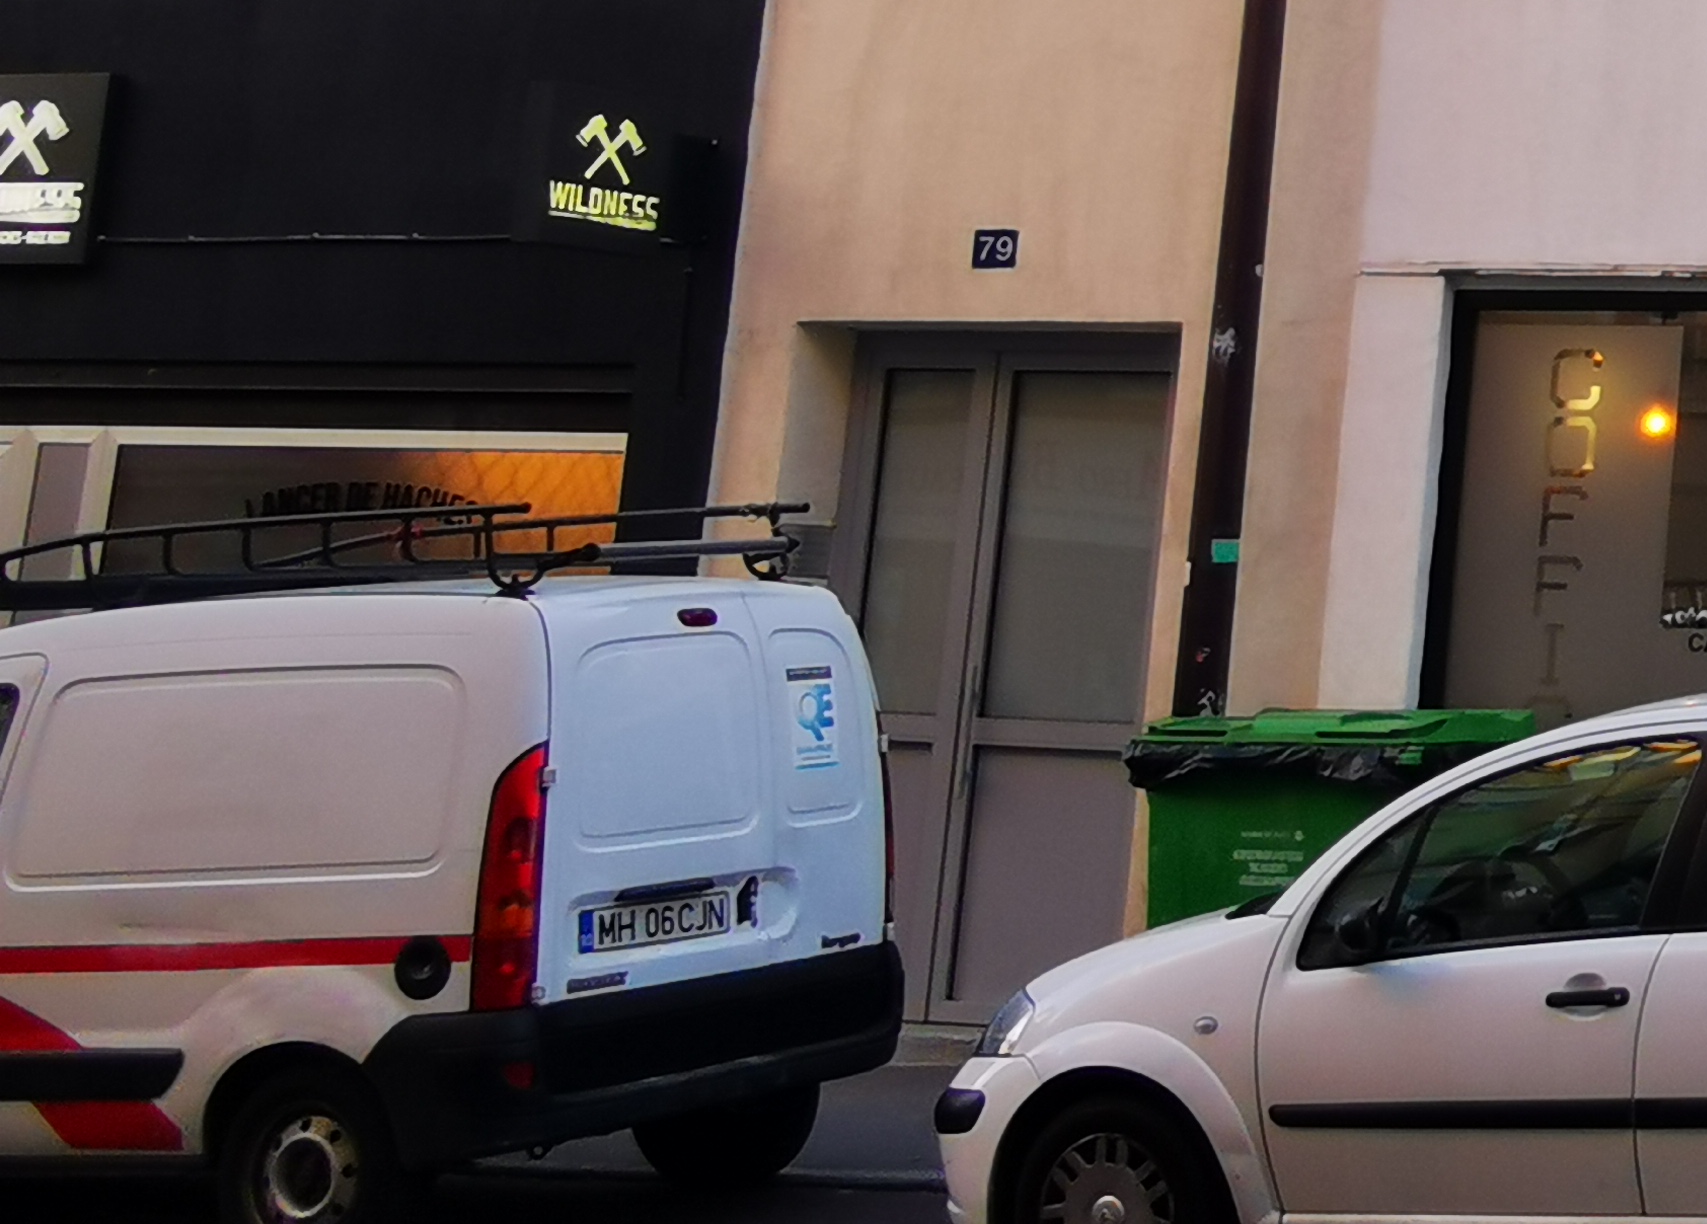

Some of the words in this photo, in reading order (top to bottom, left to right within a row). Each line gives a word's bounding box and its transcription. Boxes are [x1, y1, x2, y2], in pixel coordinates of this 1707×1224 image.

[549, 179, 661, 220] WILDNESS
[978, 235, 1014, 262] 79
[597, 908, 636, 945] MH
